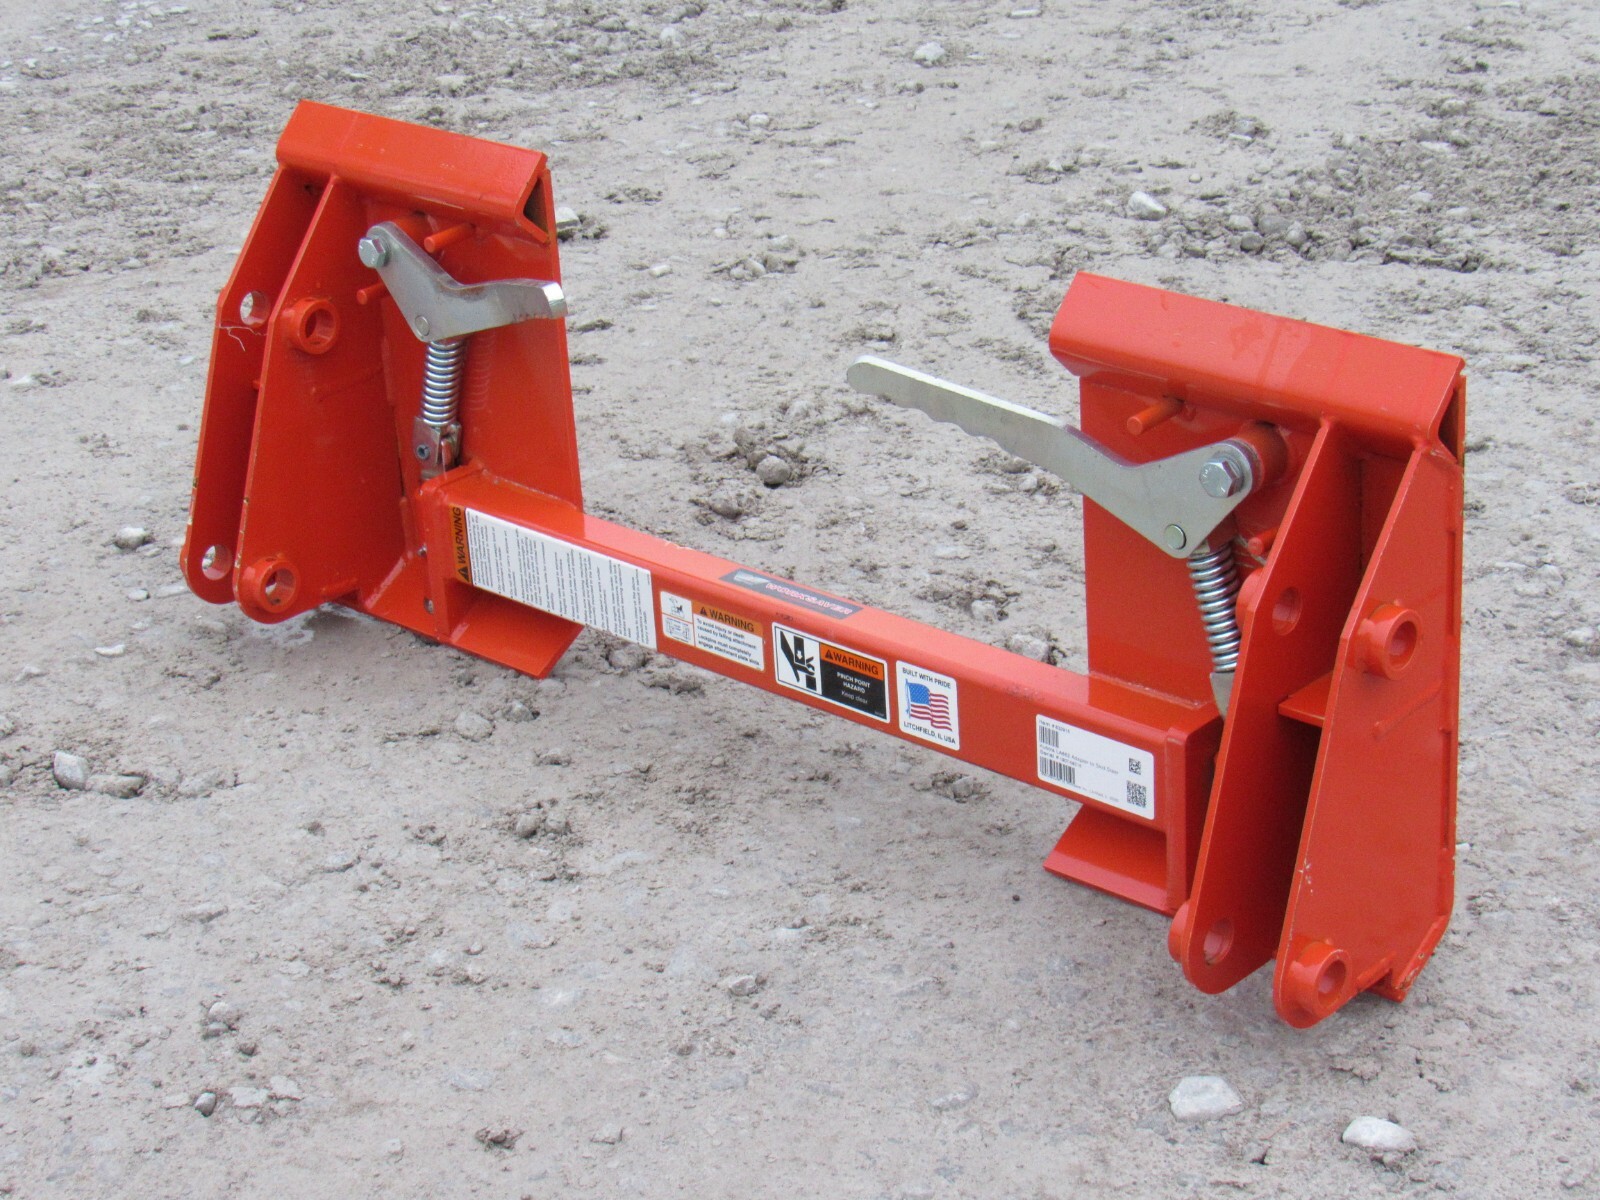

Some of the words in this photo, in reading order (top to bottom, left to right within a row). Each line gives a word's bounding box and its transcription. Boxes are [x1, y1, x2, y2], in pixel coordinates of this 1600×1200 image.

[452, 506, 466, 564] WARNING
[702, 620, 714, 628] avoid
[714, 624, 727, 634] injury
[732, 630, 745, 638] death
[709, 608, 754, 633] WARNING
[697, 625, 712, 634] caused
[718, 632, 732, 642] falling
[698, 640, 714, 650] engage
[714, 644, 738, 658] attachment
[728, 643, 752, 657] completely
[832, 651, 879, 676] WARNING
[836, 671, 854, 682] PINCH
[854, 677, 871, 689] POINT
[902, 666, 918, 678] BUILT
[918, 672, 933, 683] WITH
[934, 677, 951, 690] PRIDE
[842, 681, 866, 694] HAZARD
[841, 689, 855, 701] Keep
[855, 694, 868, 705] clear
[903, 720, 937, 738] LITCHFIELD,
[937, 732, 942, 740] IL
[943, 734, 956, 745] USA
